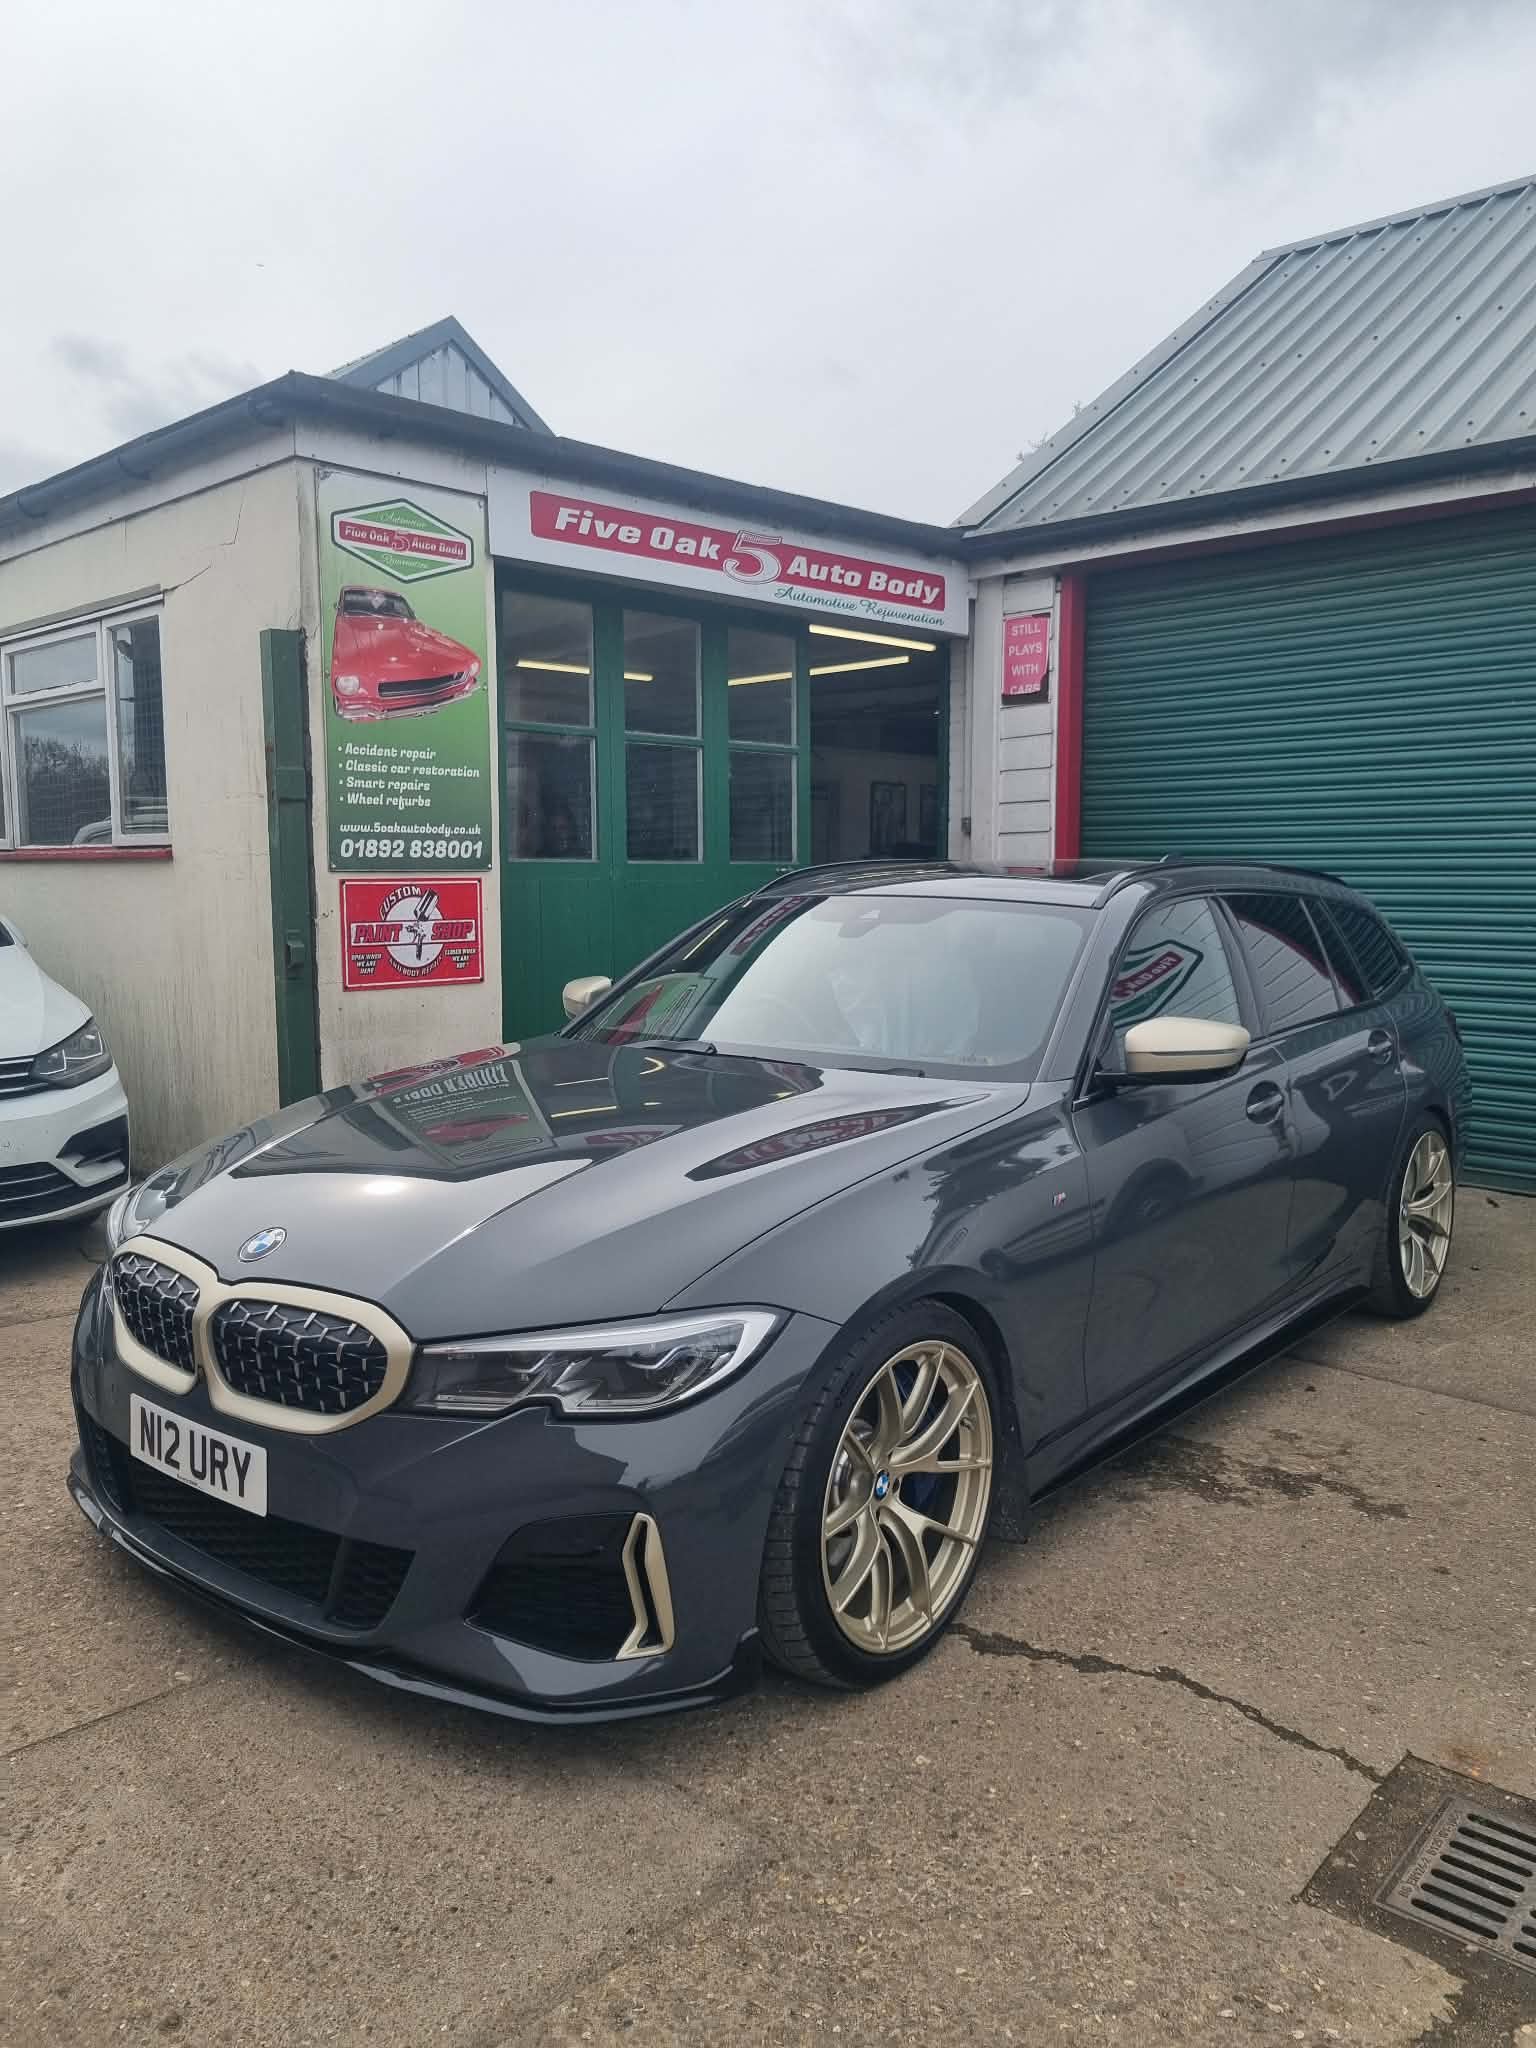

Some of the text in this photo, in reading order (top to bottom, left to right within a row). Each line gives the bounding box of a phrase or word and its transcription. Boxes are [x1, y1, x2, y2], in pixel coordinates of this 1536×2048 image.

[555, 506, 940, 605] Five Oak 5 Auto Body
[774, 586, 945, 626] Automotive Rejuvenation
[1011, 623, 1041, 636] STILL
[1008, 641, 1043, 657] PLAYS
[1011, 662, 1040, 676] WITH
[345, 743, 437, 762] Accident repair
[345, 759, 480, 778] Classic car restoration
[346, 776, 431, 793] Smart repairs
[347, 792, 432, 810] Wheel refurbs
[340, 822, 481, 837] www.5oakautobody.co.uk
[340, 838, 483, 858] 01892 838001
[380, 886, 422, 920] CUSTOM
[354, 921, 474, 942] PAINT SHOP
[140, 1406, 251, 1498] N12 URY
